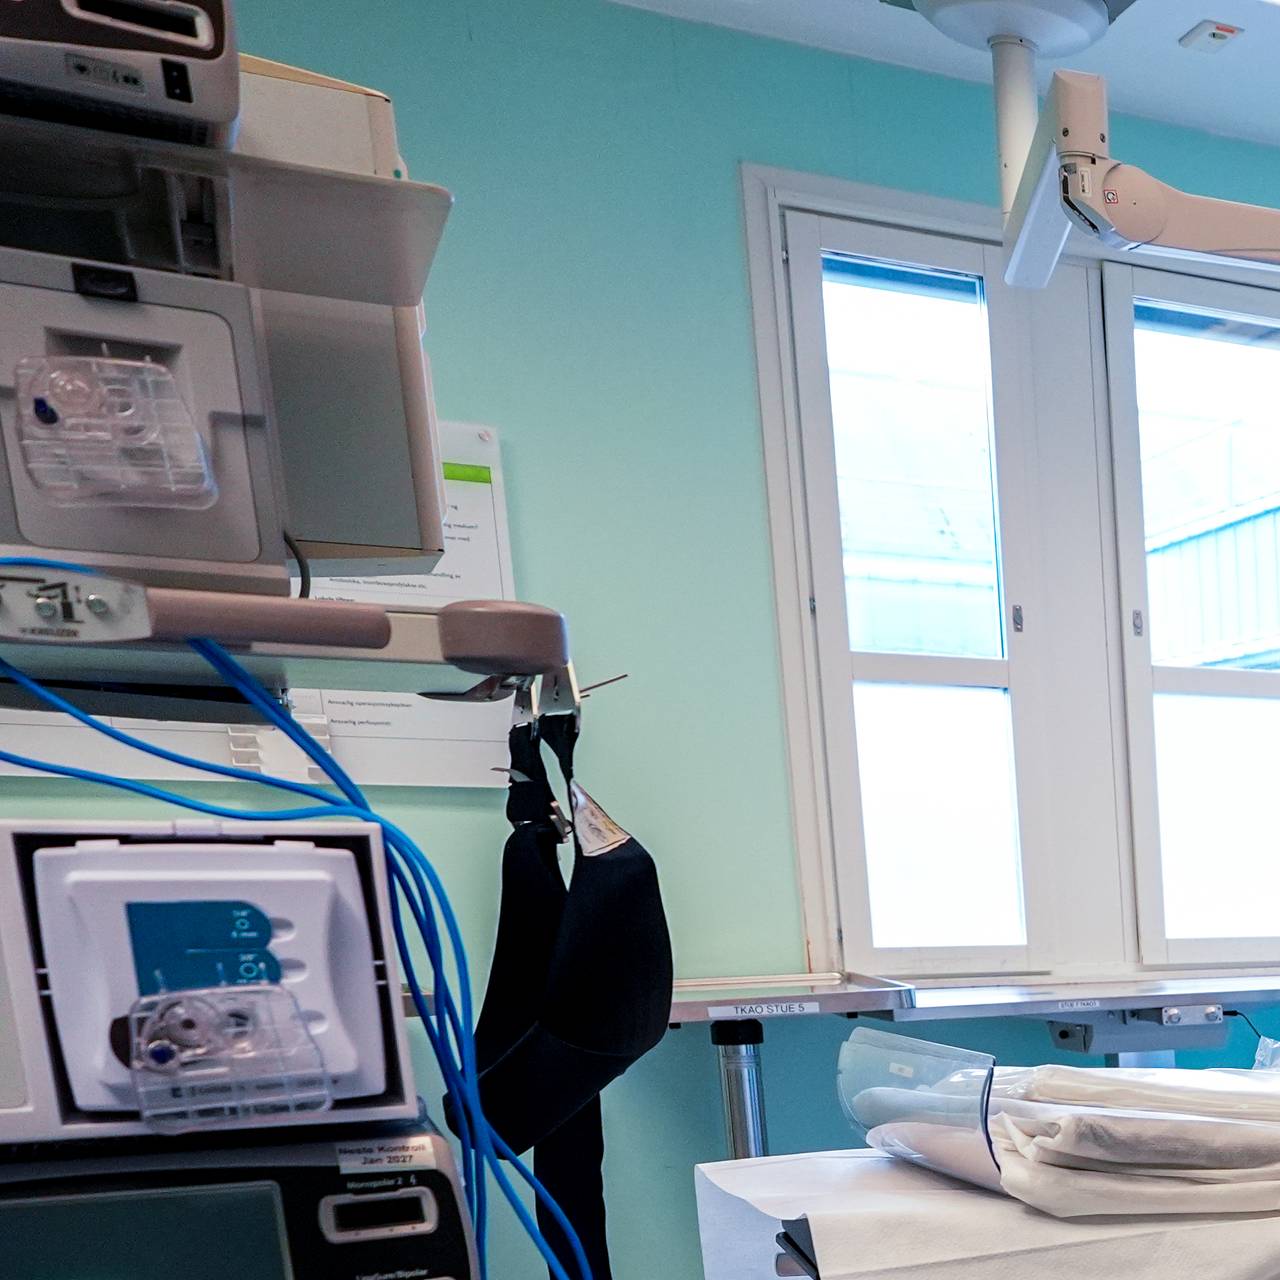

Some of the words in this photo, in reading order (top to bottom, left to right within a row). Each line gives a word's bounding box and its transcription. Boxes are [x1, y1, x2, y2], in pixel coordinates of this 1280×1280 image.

[734, 1004, 764, 1015] TKAO
[766, 1002, 795, 1014] STUE
[798, 1002, 805, 1013] 5
[361, 1155, 383, 1165] Jan
